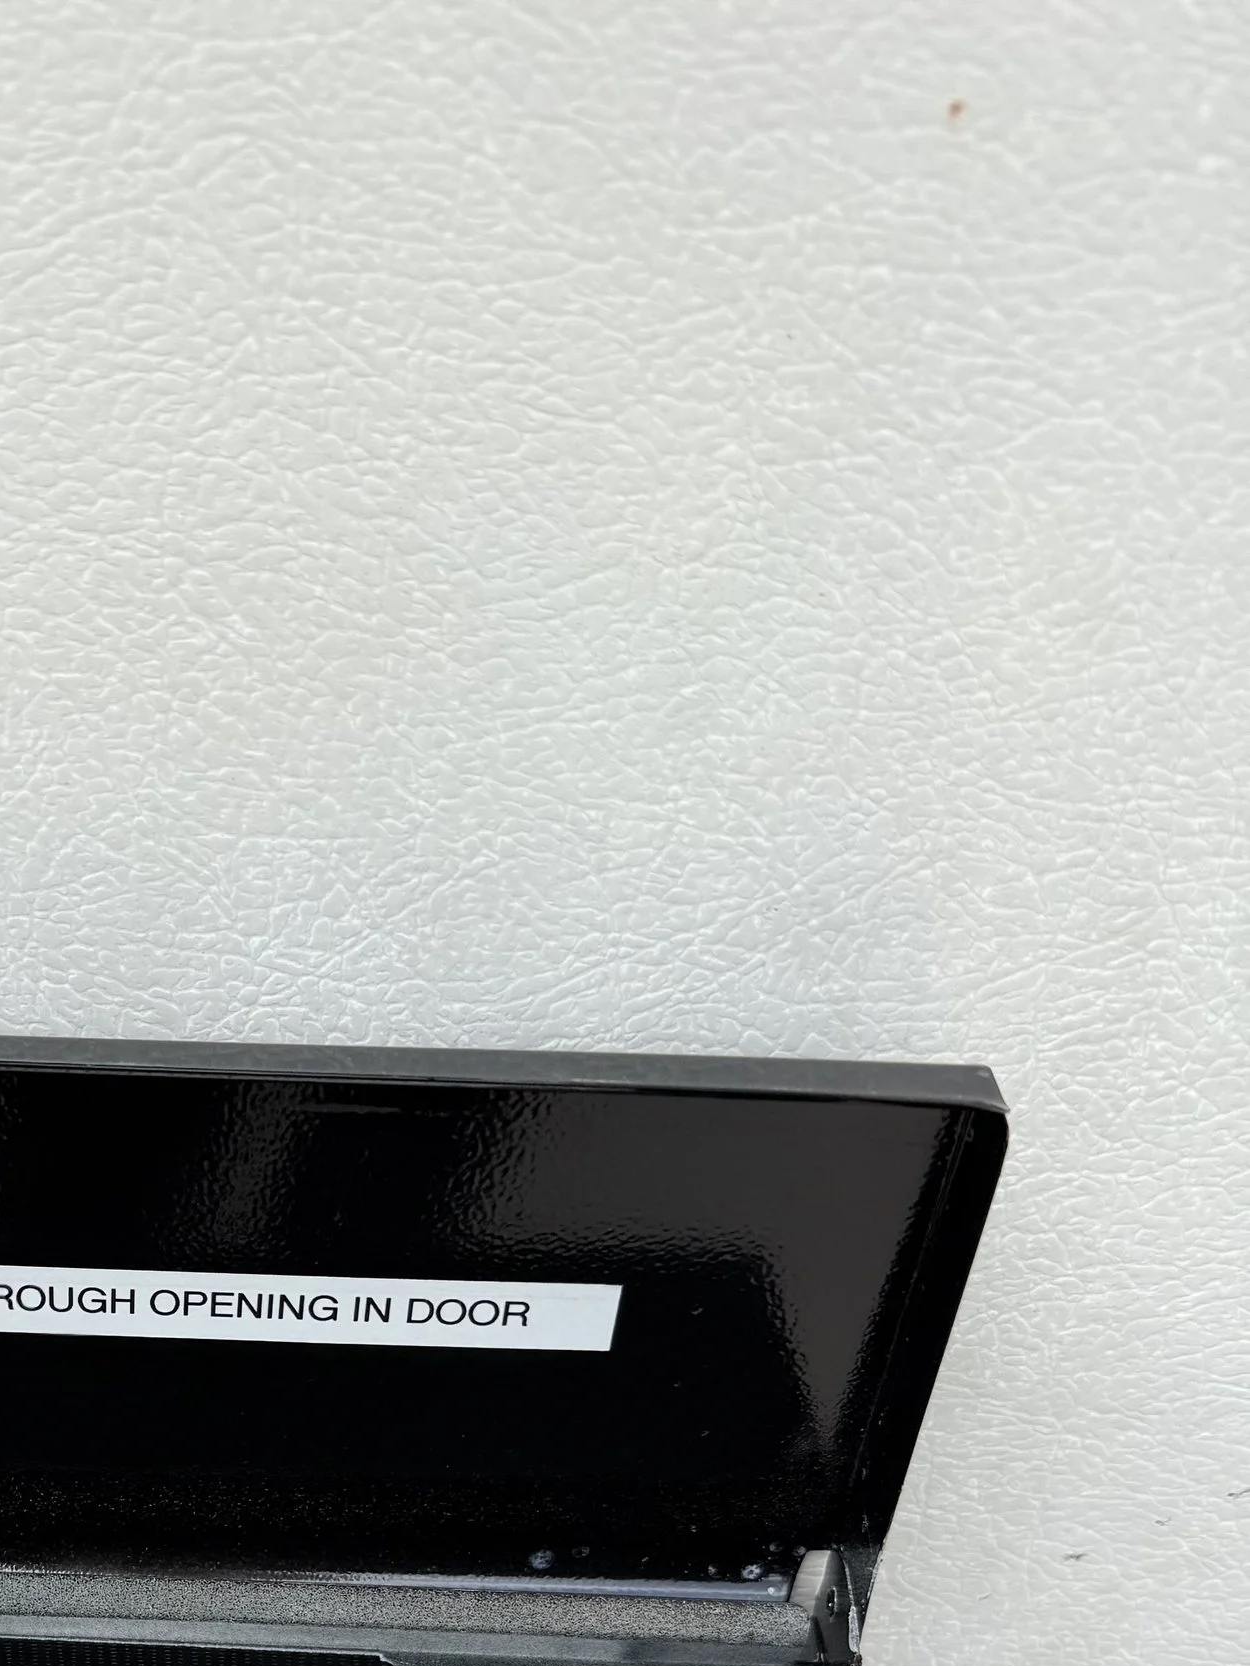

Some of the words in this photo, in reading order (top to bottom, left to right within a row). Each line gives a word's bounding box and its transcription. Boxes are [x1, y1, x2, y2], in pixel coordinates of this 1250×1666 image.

[149, 1289, 339, 1322] OPENING
[353, 1296, 392, 1323] IN
[406, 1298, 531, 1327] DOOR
